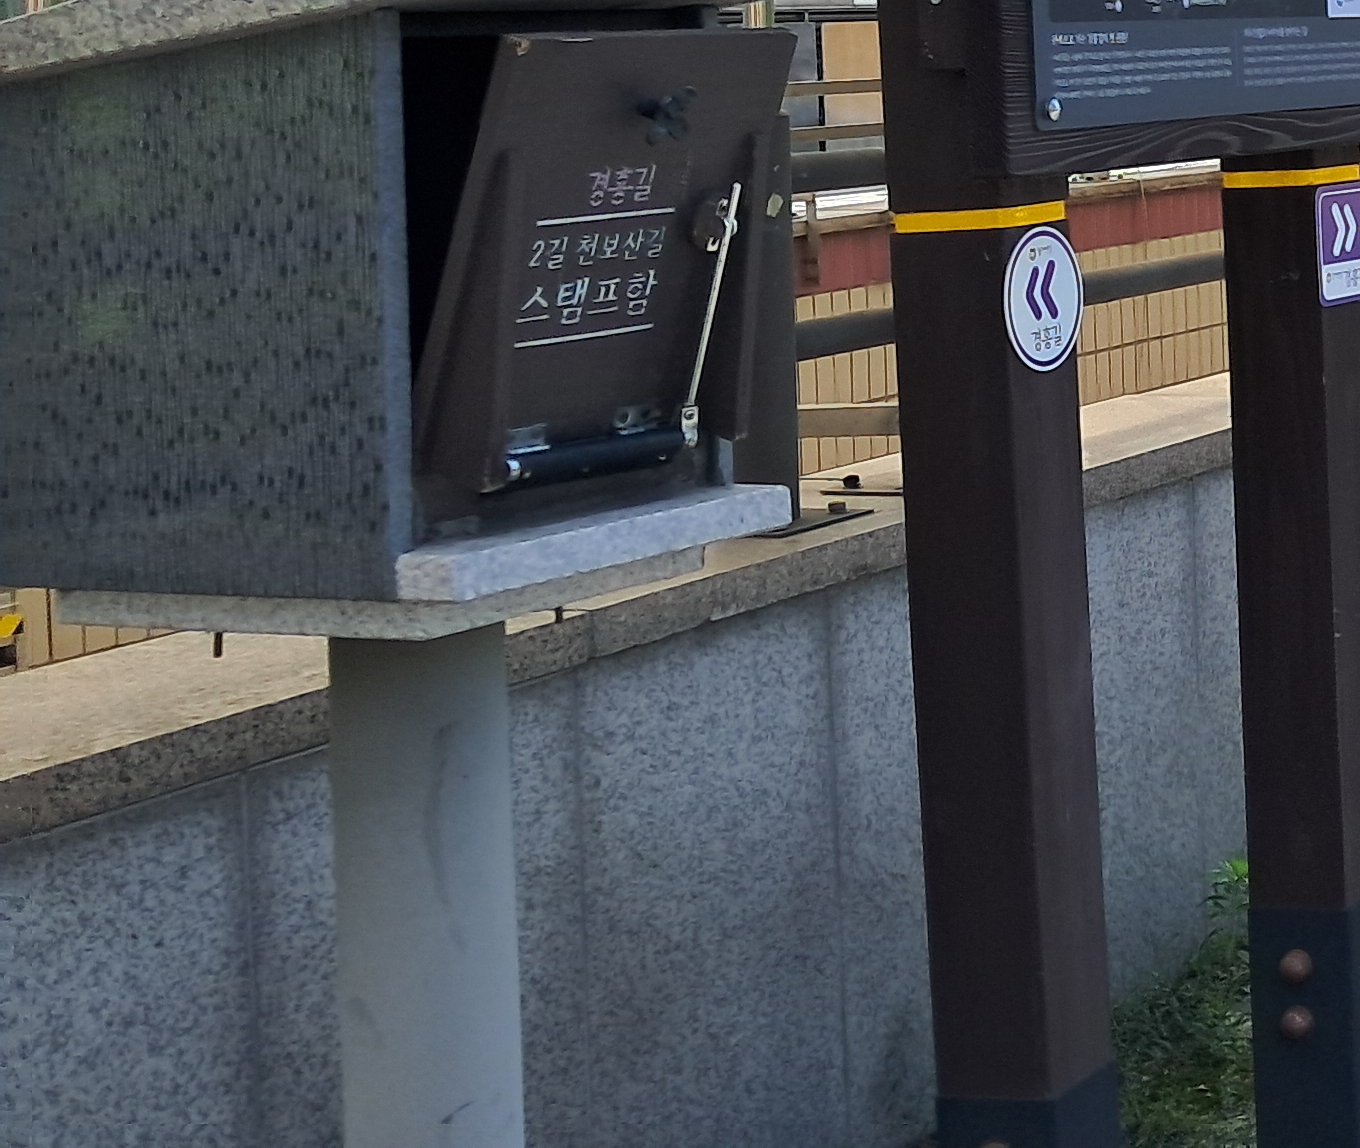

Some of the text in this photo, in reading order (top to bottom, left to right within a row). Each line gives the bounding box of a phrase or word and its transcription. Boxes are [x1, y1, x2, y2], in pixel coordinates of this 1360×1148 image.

[528, 226, 667, 270] 2길 천보산길
[515, 268, 658, 326] 스탬프함
